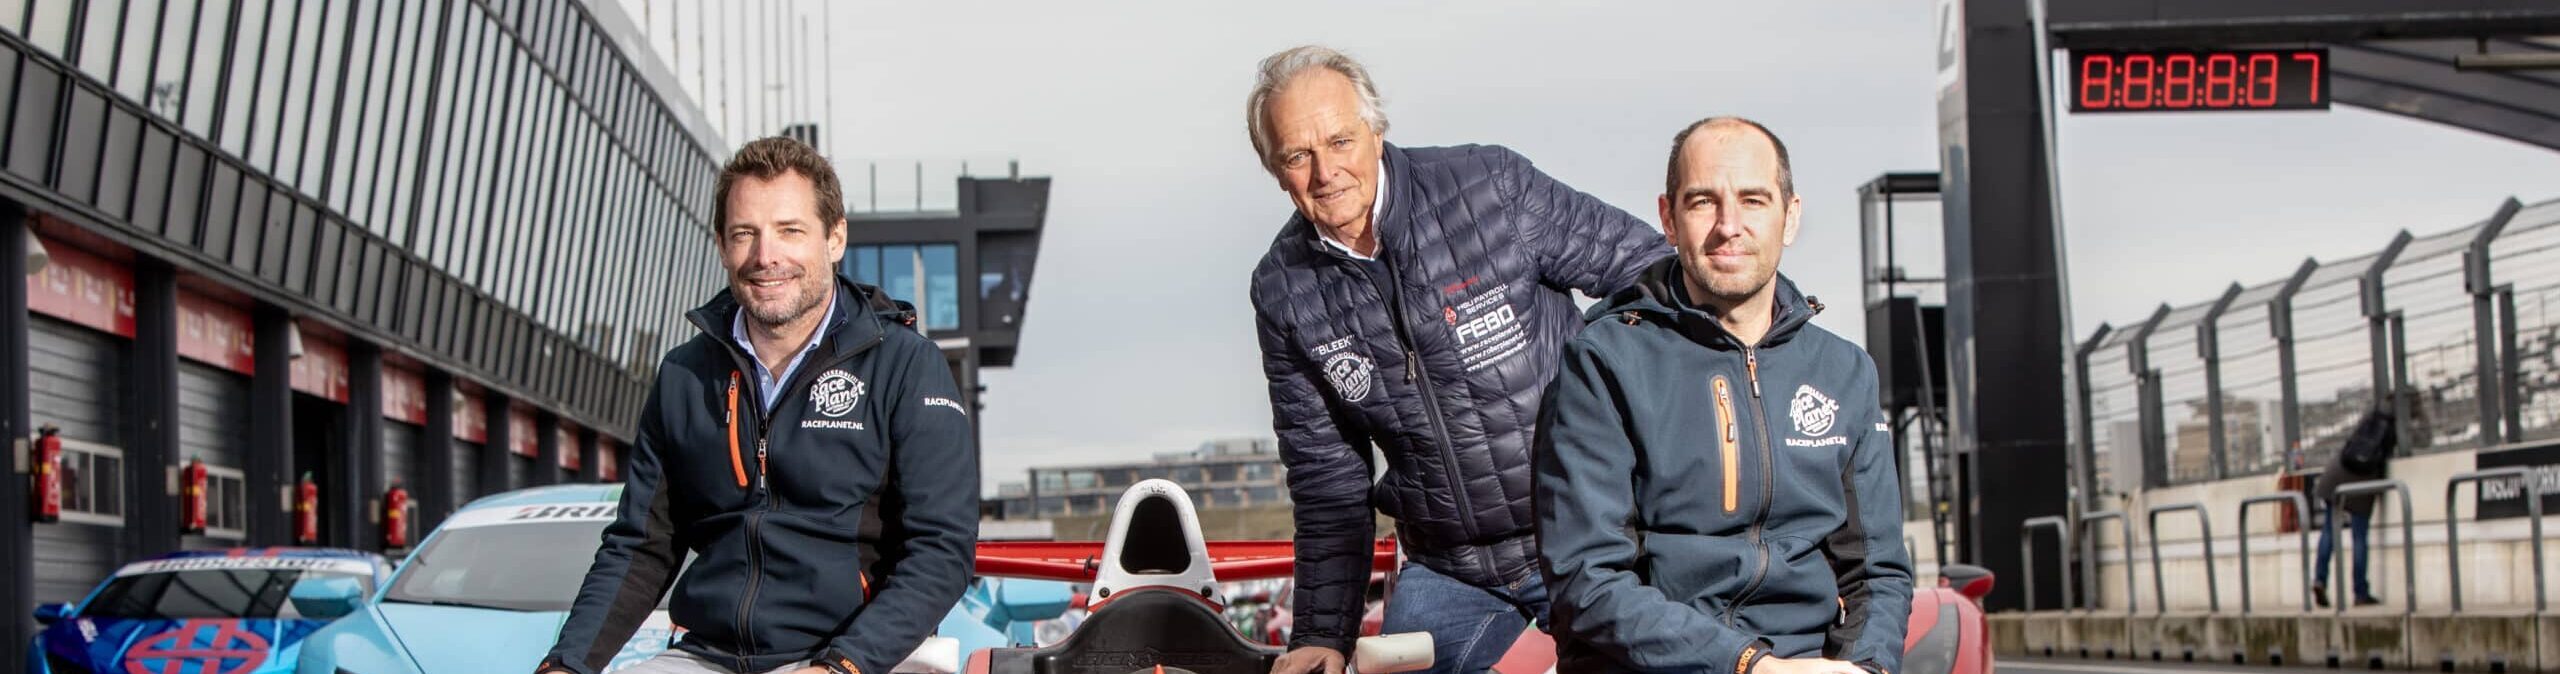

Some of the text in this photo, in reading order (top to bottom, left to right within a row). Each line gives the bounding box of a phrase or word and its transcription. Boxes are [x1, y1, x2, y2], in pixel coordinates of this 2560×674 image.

[1466, 292, 1505, 315] SERVICES
[1474, 283, 1509, 304] PAYROLL
[1456, 304, 1516, 345] FEBO
[809, 378, 846, 401] Race
[815, 380, 865, 412] Planet
[801, 420, 865, 430] RACEPLANET.NL
[1793, 399, 1840, 431] Planet
